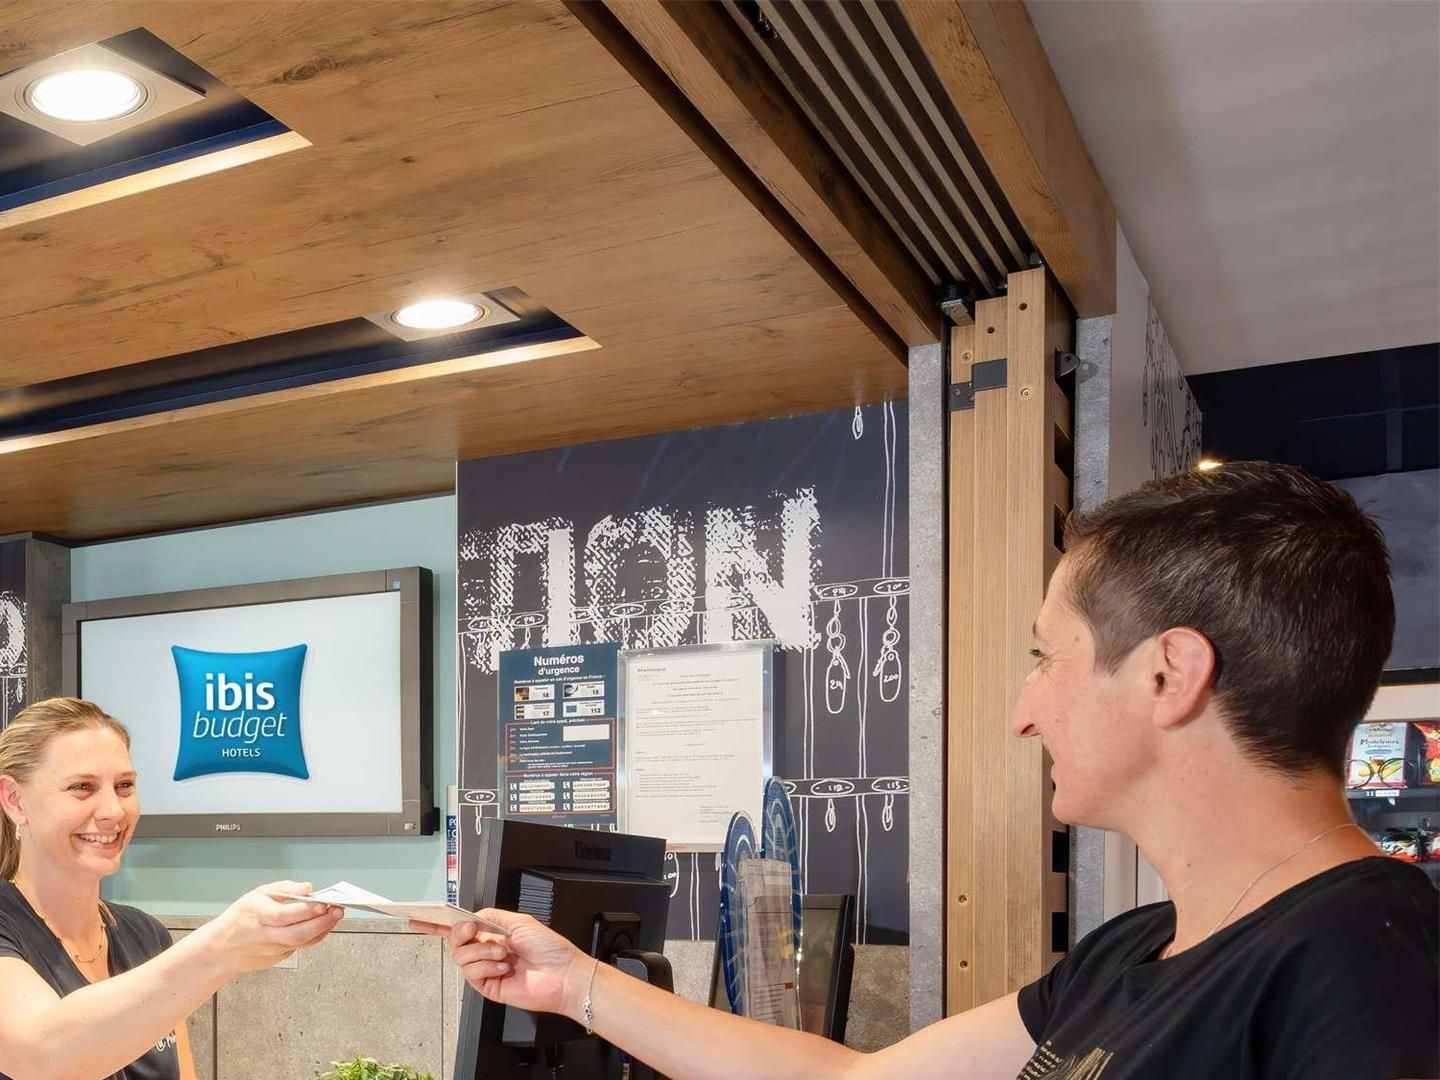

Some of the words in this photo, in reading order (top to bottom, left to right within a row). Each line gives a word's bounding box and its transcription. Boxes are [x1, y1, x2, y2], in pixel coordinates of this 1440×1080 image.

[534, 654, 585, 667] Numéros
[538, 666, 580, 676] d'urgence
[205, 672, 276, 711] ibis
[193, 711, 287, 744] budget
[221, 748, 260, 758] HOTELS
[215, 823, 241, 831] PHILIPS
